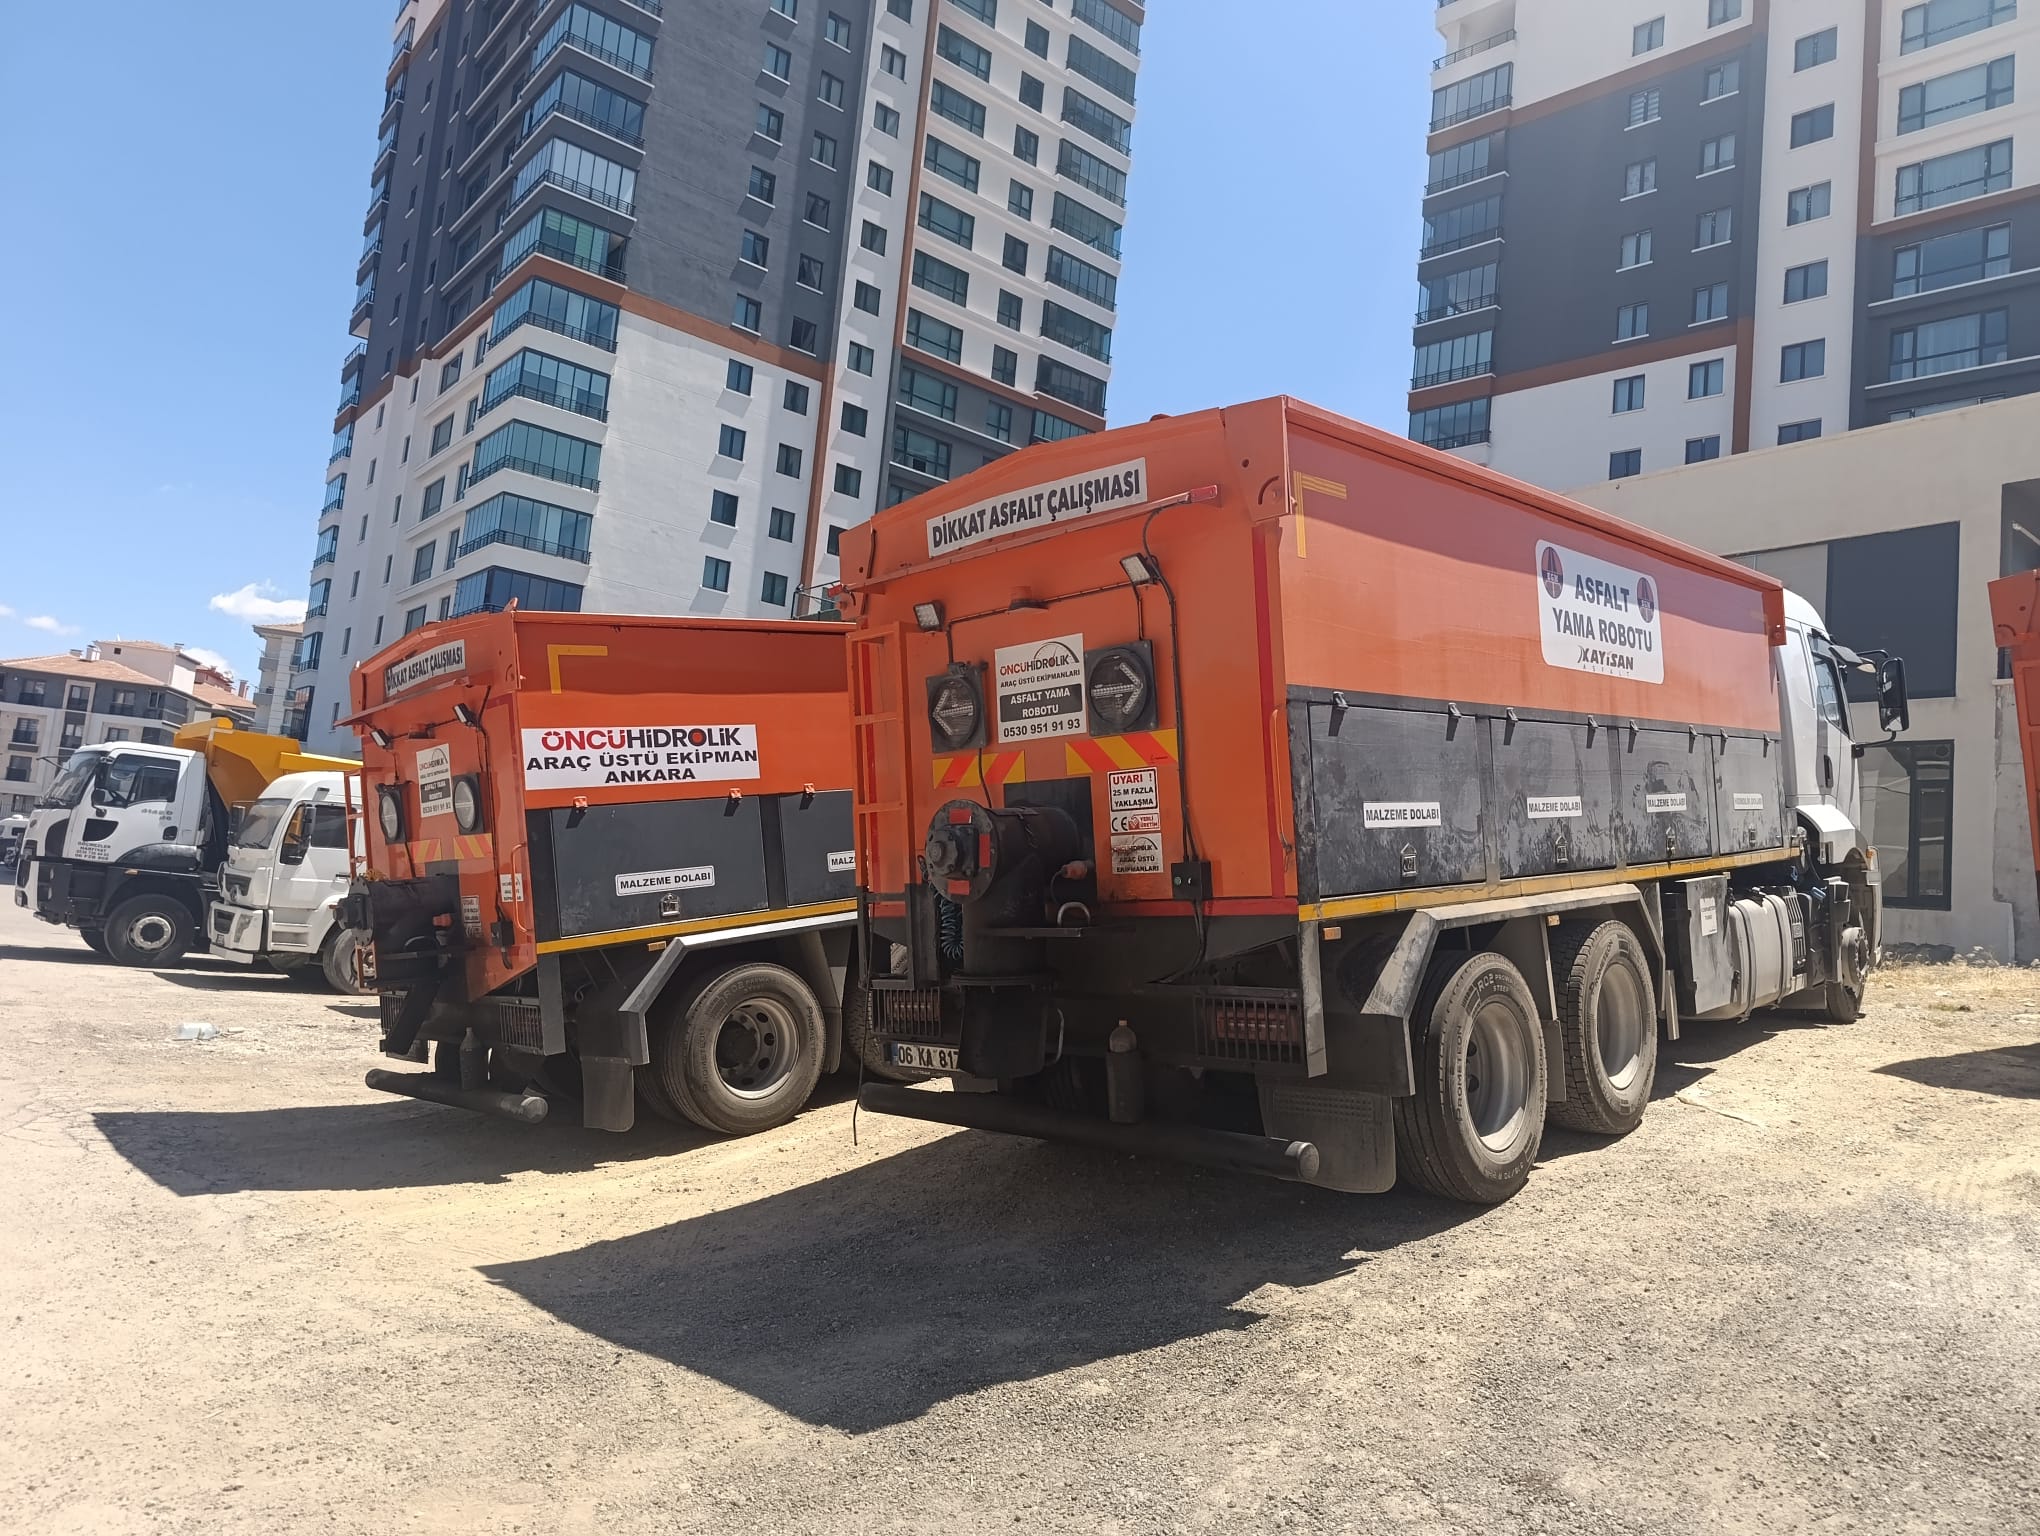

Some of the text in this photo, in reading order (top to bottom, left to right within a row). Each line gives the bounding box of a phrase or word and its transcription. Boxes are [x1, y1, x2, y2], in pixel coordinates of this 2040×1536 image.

[932, 469, 1140, 548] DİKKAT ASFALT ÇALIŞMASI
[1575, 574, 1630, 613] ASFALT
[1552, 607, 1653, 652] YAMA ROBOTU
[408, 657, 430, 682] ASFALT
[429, 646, 464, 676] ÇALIŞMASI
[1000, 669, 1081, 689] ARAÇ ÜSTÜ EKİPMANLARI
[1010, 687, 1071, 705] ASFALT YAMA
[1022, 704, 1059, 719] ROBOTU
[1003, 718, 1081, 738] 0530 951 91 93
[526, 749, 758, 772] ARAÇ ÜSTÜ EKİPMAN
[604, 768, 696, 784] ANKARA
[1112, 773, 1143, 785] UYARI
[1112, 786, 1154, 796] 25 M FAZLA
[1113, 798, 1154, 808] YAKLAŞMA
[1528, 802, 1581, 813] MALZEME DOLABI
[1647, 799, 1670, 808] MALZEME
[1365, 807, 1440, 821] MALZEME DOLABI
[831, 857, 856, 867] MALZ
[620, 872, 711, 890] MALZEME DOLABI
[898, 1046, 914, 1065] 06
[917, 1047, 934, 1068] KA
